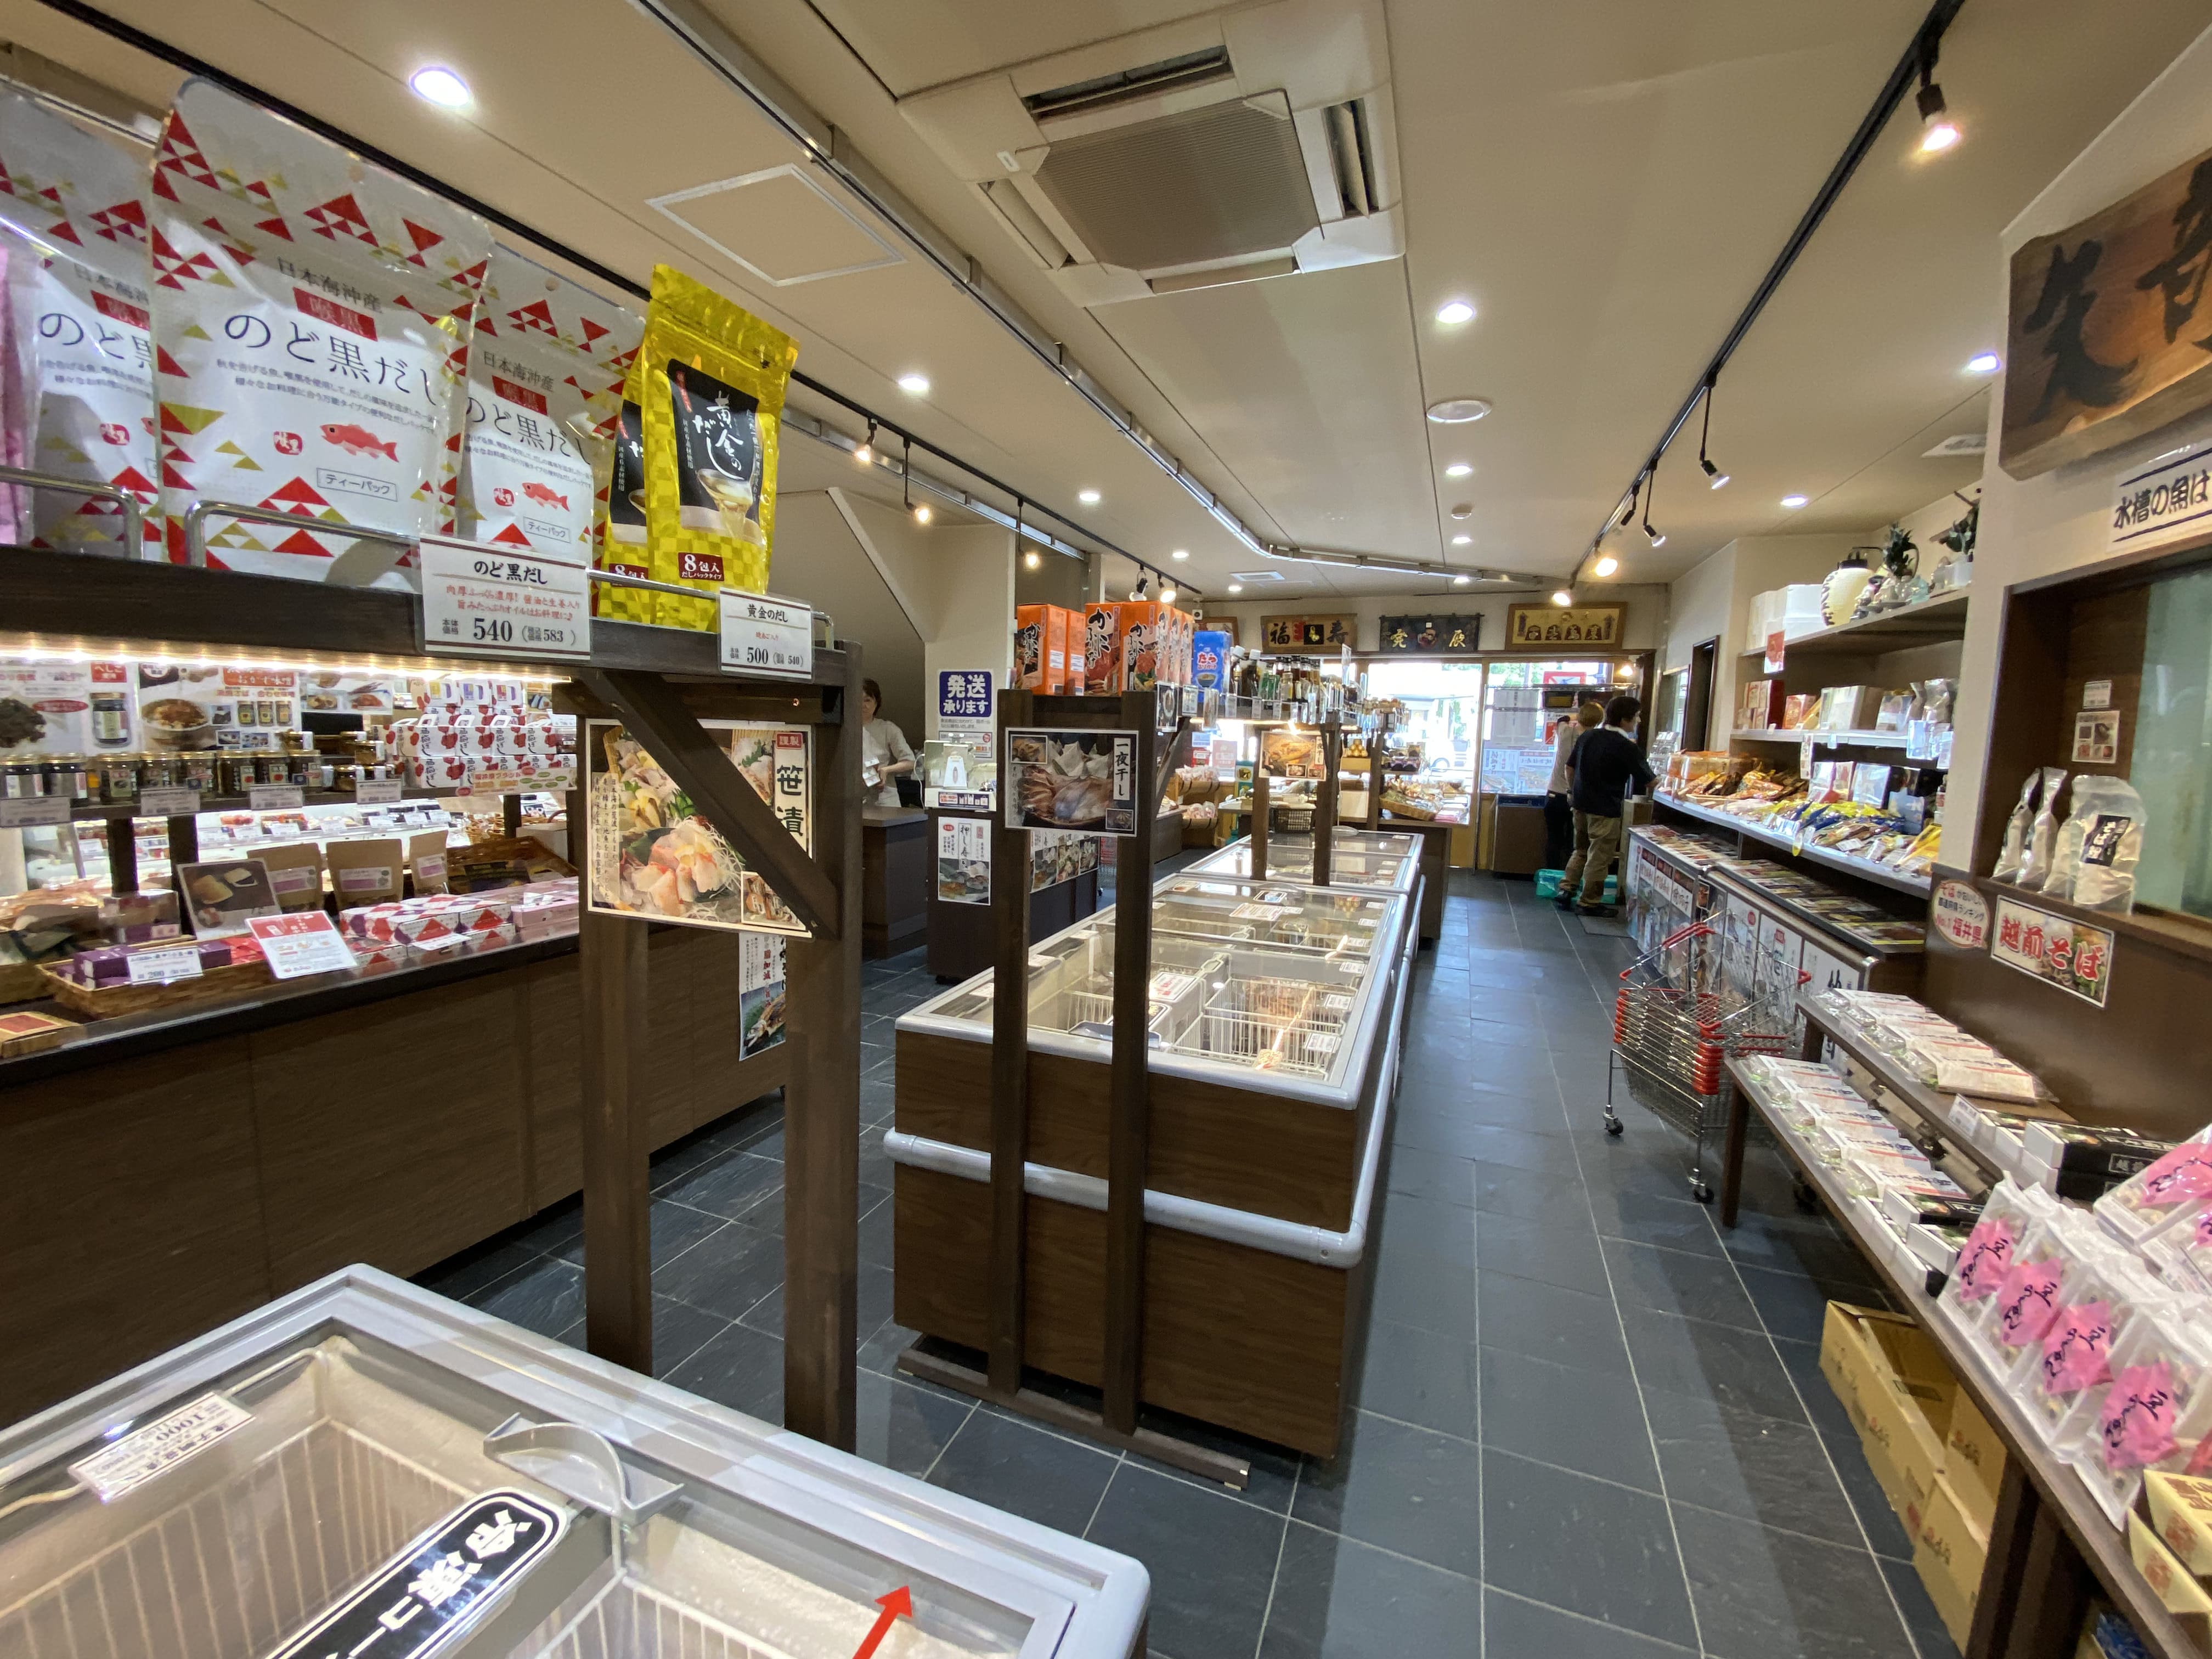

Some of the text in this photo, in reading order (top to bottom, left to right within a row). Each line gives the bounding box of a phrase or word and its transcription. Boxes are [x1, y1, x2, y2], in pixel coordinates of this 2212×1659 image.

[224, 314, 436, 406] のど黒だし
[325, 474, 391, 495] ティーパック
[2113, 471, 2210, 531] 水槽の魚は
[528, 521, 566, 538] ティーパック
[473, 561, 548, 584] のど黒だし
[684, 554, 719, 572] 8包入
[681, 571, 723, 580] だしパックタイプ
[747, 603, 788, 623] 黄金のだし
[473, 617, 512, 642] 540
[543, 629, 563, 642] 583
[1269, 622, 1291, 645] 福
[747, 646, 769, 664] 500
[1197, 652, 1218, 664] たら
[947, 674, 986, 698] 発送
[943, 699, 989, 714] 承ります
[1115, 742, 1130, 797] 一夜干し
[776, 764, 804, 837] 笹漬
[960, 825, 970, 868] 押し寿司
[1953, 917, 1982, 945] 福井県
[1999, 913, 2104, 981] 越前そば
